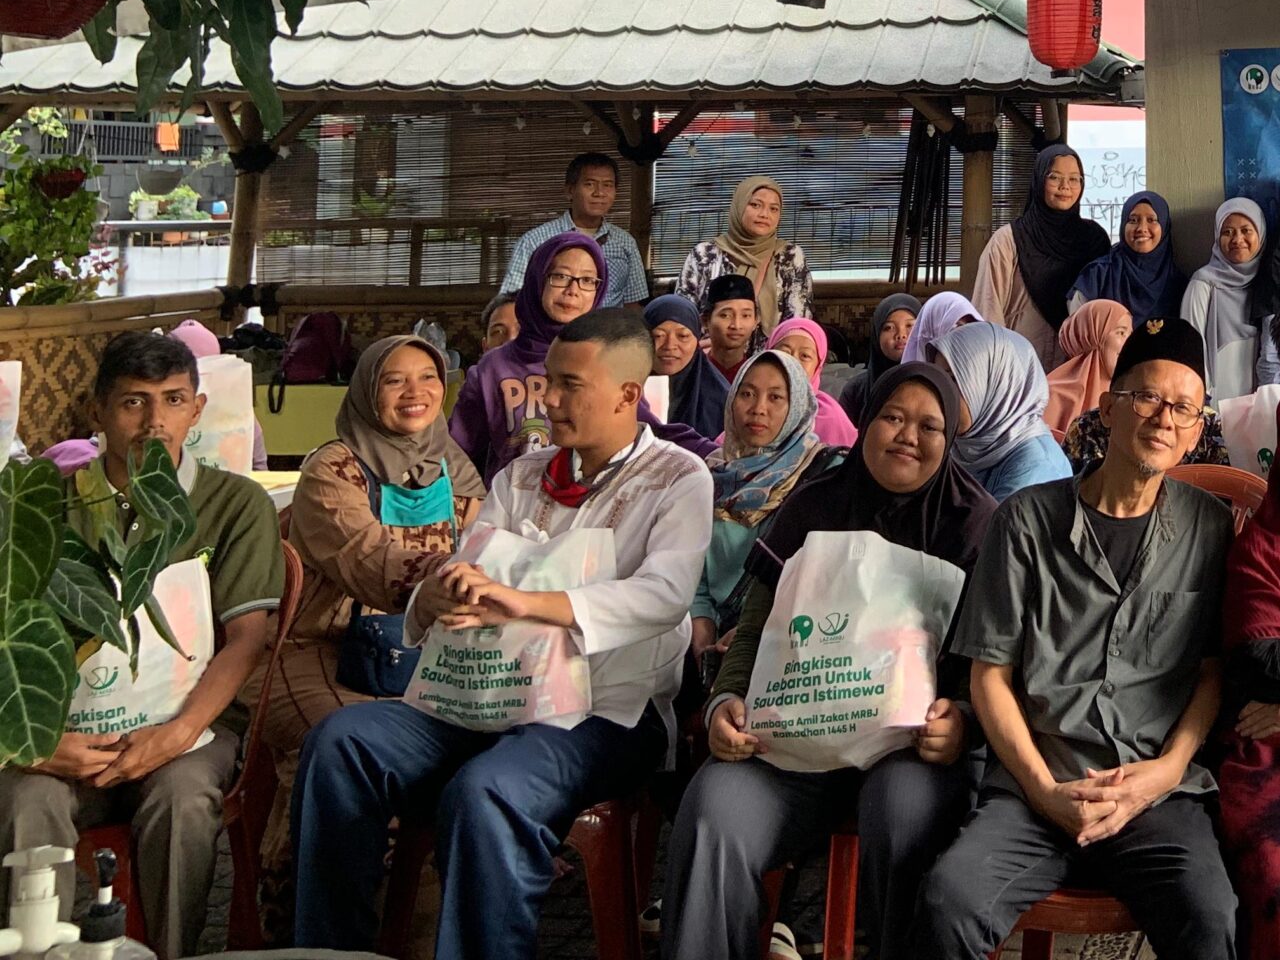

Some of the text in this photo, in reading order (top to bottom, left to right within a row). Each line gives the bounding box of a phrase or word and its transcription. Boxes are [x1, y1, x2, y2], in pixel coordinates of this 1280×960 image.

[500, 374, 548, 433] PR
[442, 644, 503, 663] Bingkisan
[478, 658, 522, 675] Untuk
[784, 654, 853, 676] Bingkisan
[468, 674, 533, 690] Istimewa
[765, 667, 872, 694] Lebaran Untuk
[474, 700, 501, 710] Zakat
[503, 698, 527, 708] MRBJ
[752, 682, 885, 710] Saudara Istimewa
[68, 706, 126, 726] gkisan
[98, 712, 148, 734] Untuk
[750, 708, 879, 731] Lembaga Amil Zakat MRBJ
[772, 722, 856, 739] Ramadhan 1445 H
